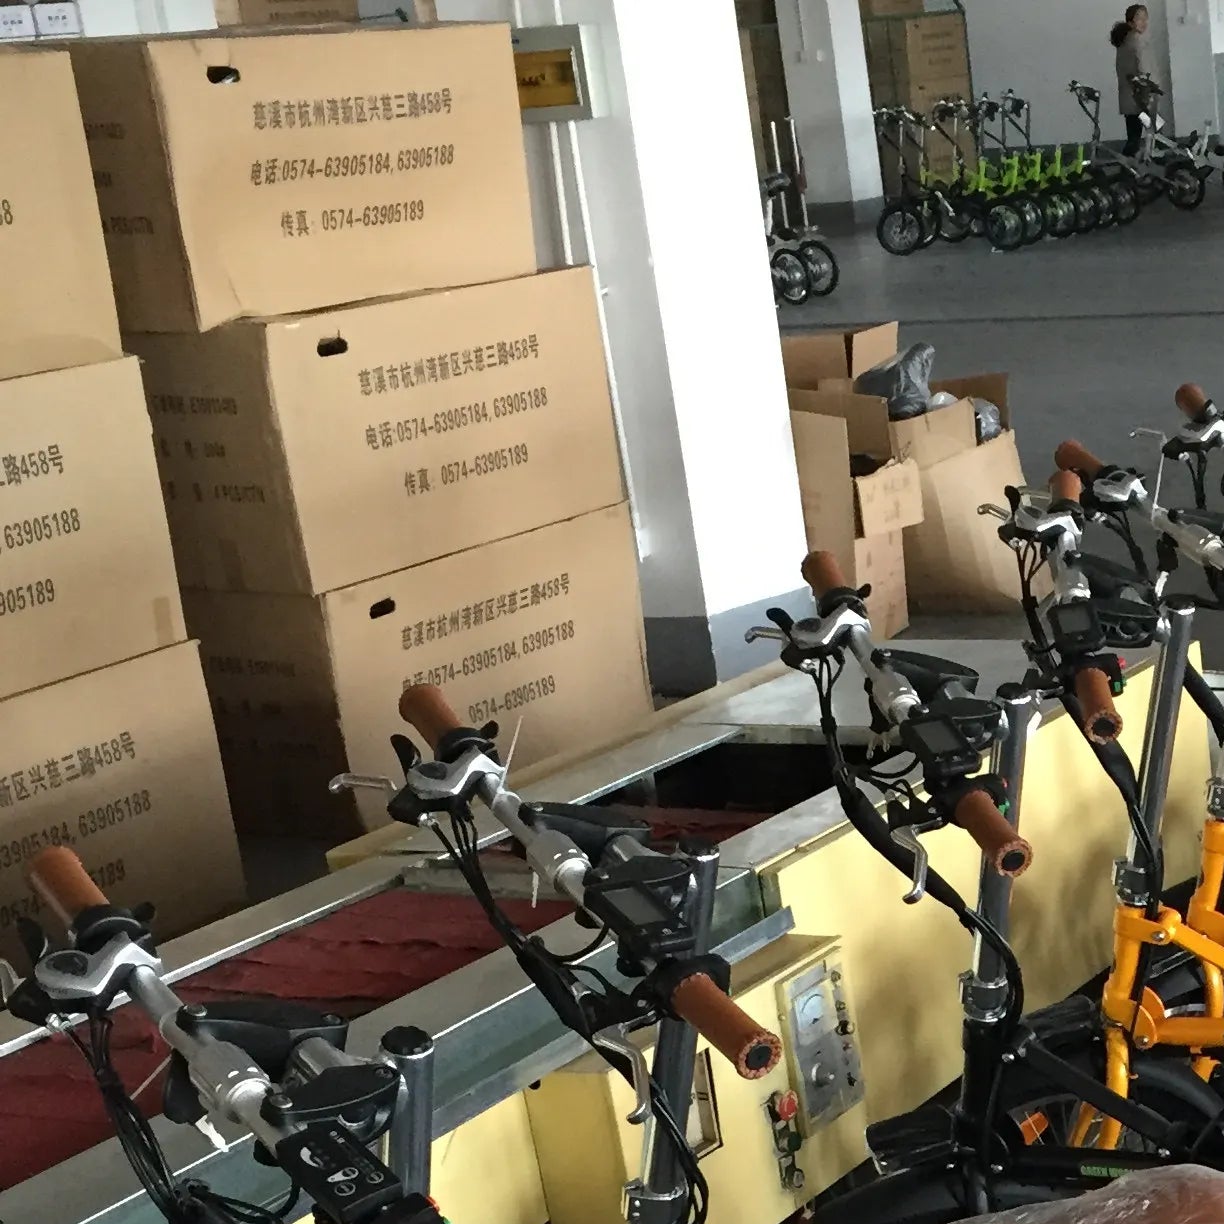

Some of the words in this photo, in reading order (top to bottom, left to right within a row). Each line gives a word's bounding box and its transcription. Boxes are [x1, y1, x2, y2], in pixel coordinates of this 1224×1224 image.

[321, 199, 425, 231] 0574-63905189
[493, 386, 549, 418] 63905188
[441, 443, 530, 485] 0574-63905189
[521, 619, 576, 655] 63905188
[468, 675, 556, 724] 0574-63905189
